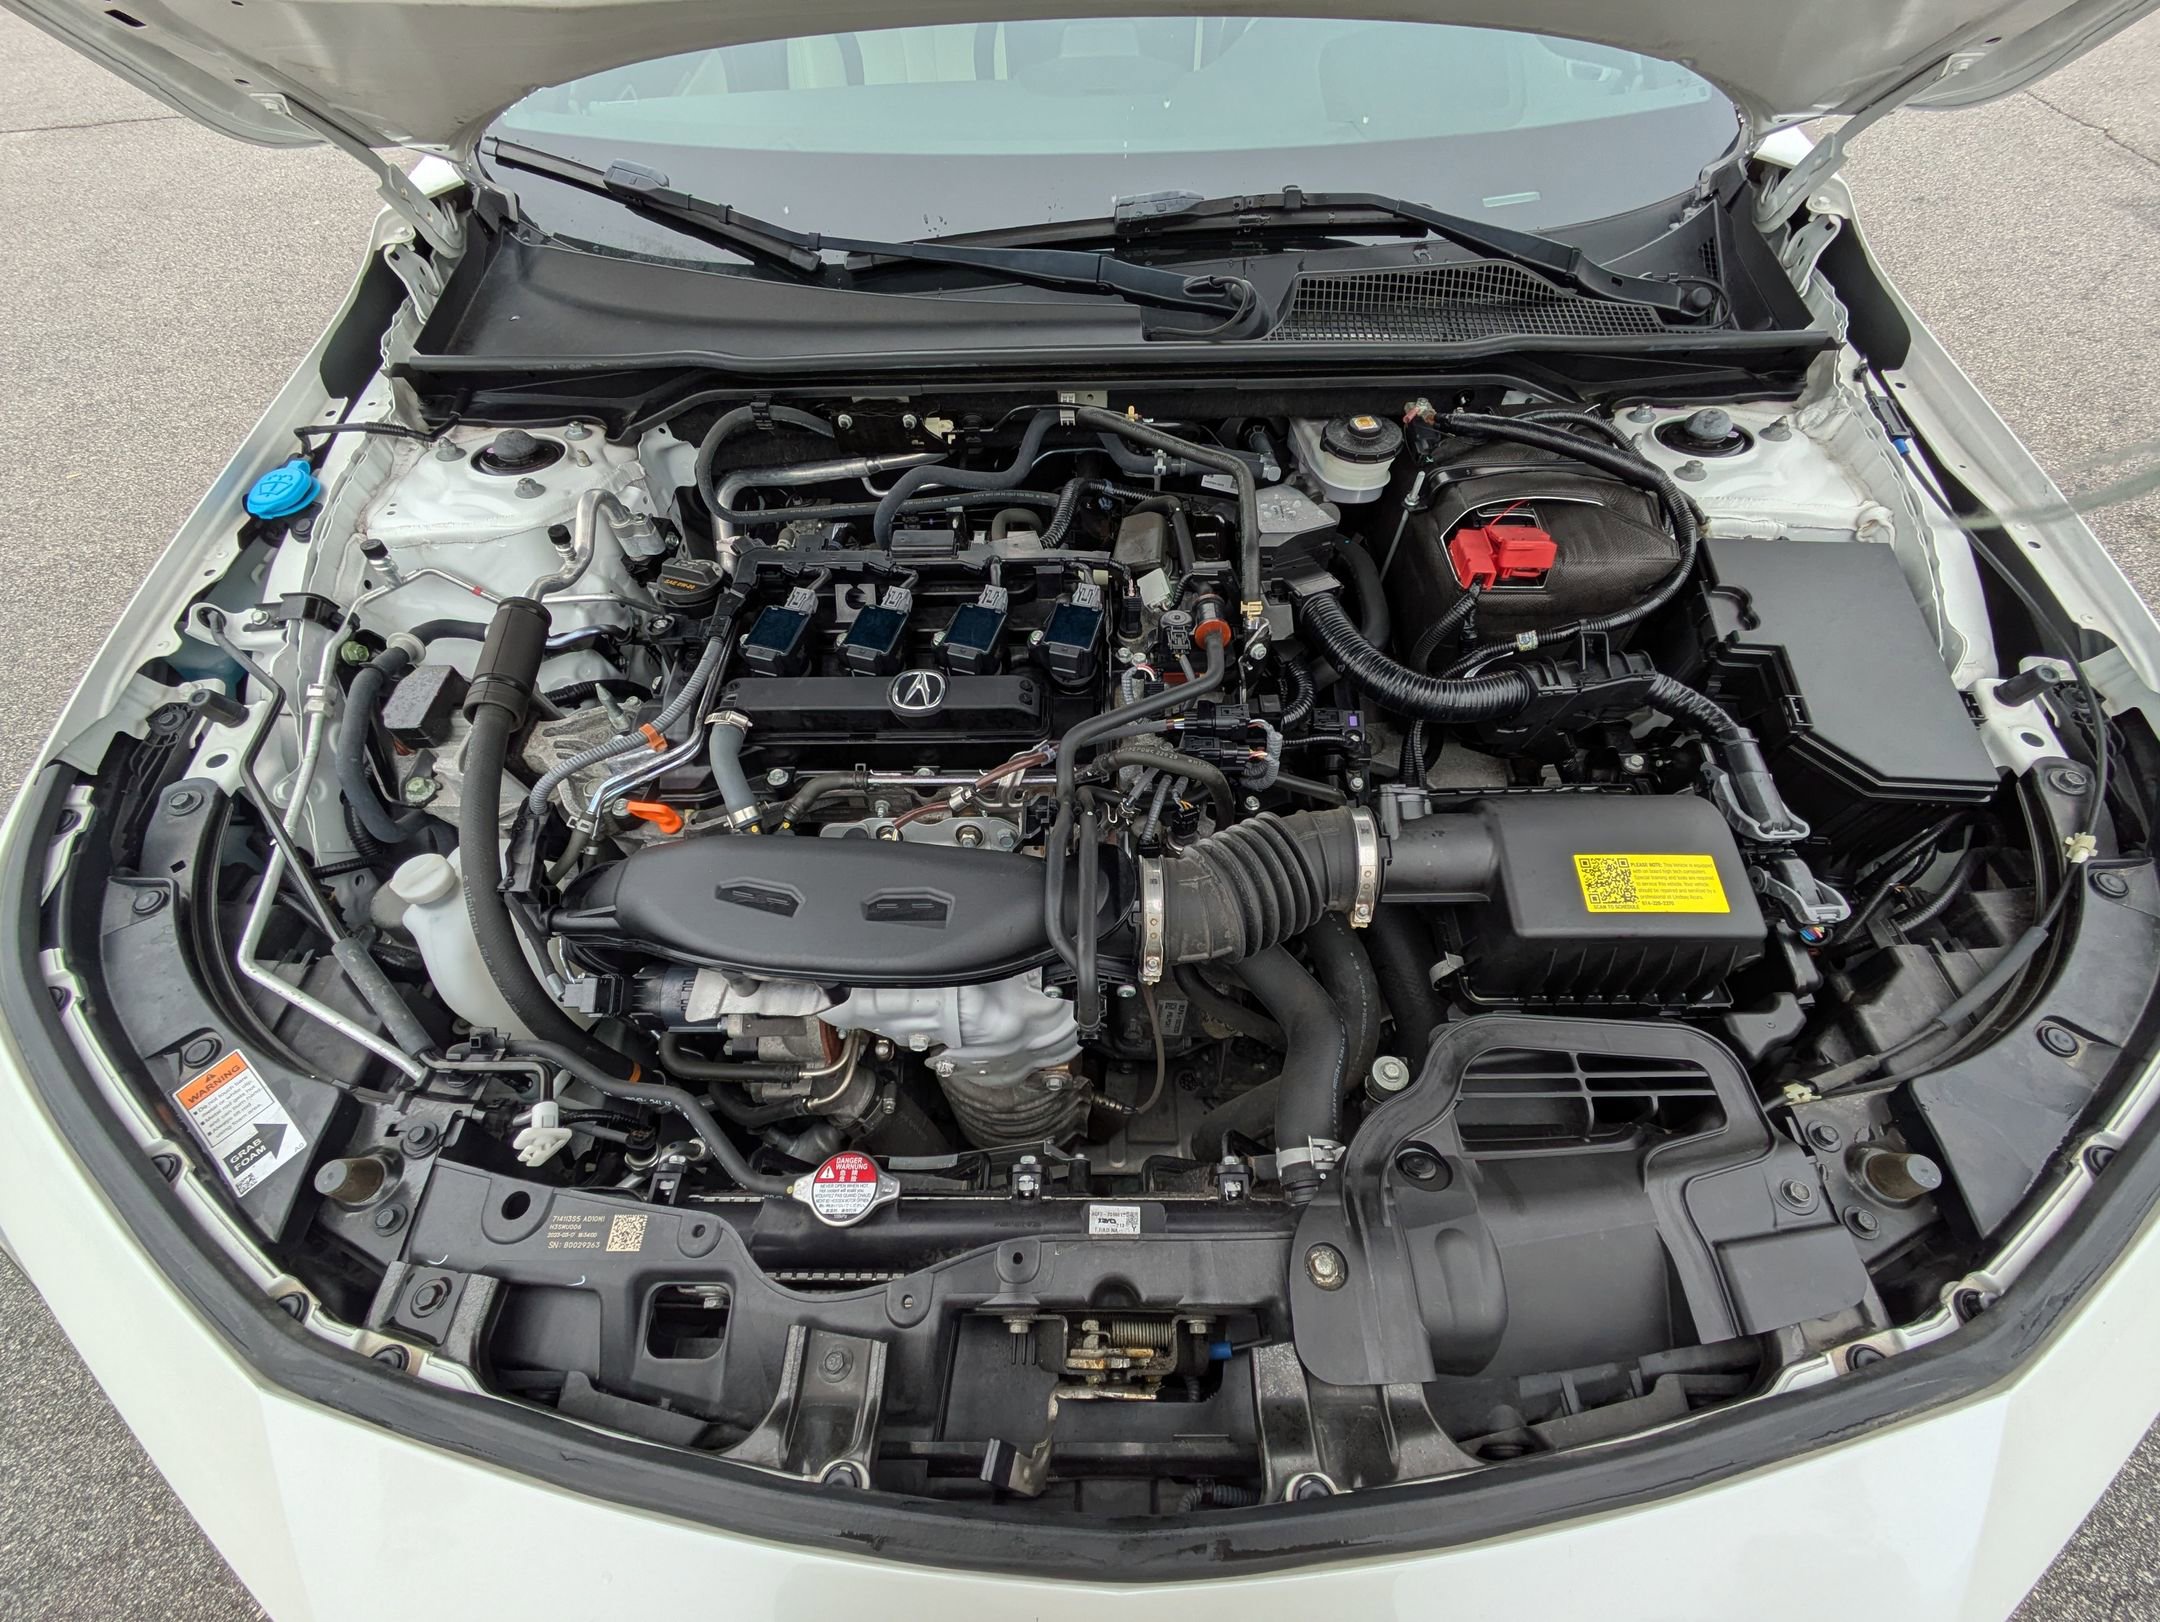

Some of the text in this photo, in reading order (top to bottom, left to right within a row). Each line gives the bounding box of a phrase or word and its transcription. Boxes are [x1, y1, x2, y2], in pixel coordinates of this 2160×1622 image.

[188, 1065, 240, 1103] WARNING
[208, 1097, 217, 1105] not
[218, 1086, 234, 1097] touch
[205, 1110, 221, 1122] Metal
[222, 1102, 232, 1110] rod
[212, 1117, 233, 1133] Always
[241, 1103, 251, 1111] rod
[232, 1114, 247, 1126] foam
[229, 1138, 262, 1164] GRAB
[234, 1145, 266, 1171] FOAM
[1131, 1224, 1136, 1232] Y
[548, 1241, 562, 1249] SN:
